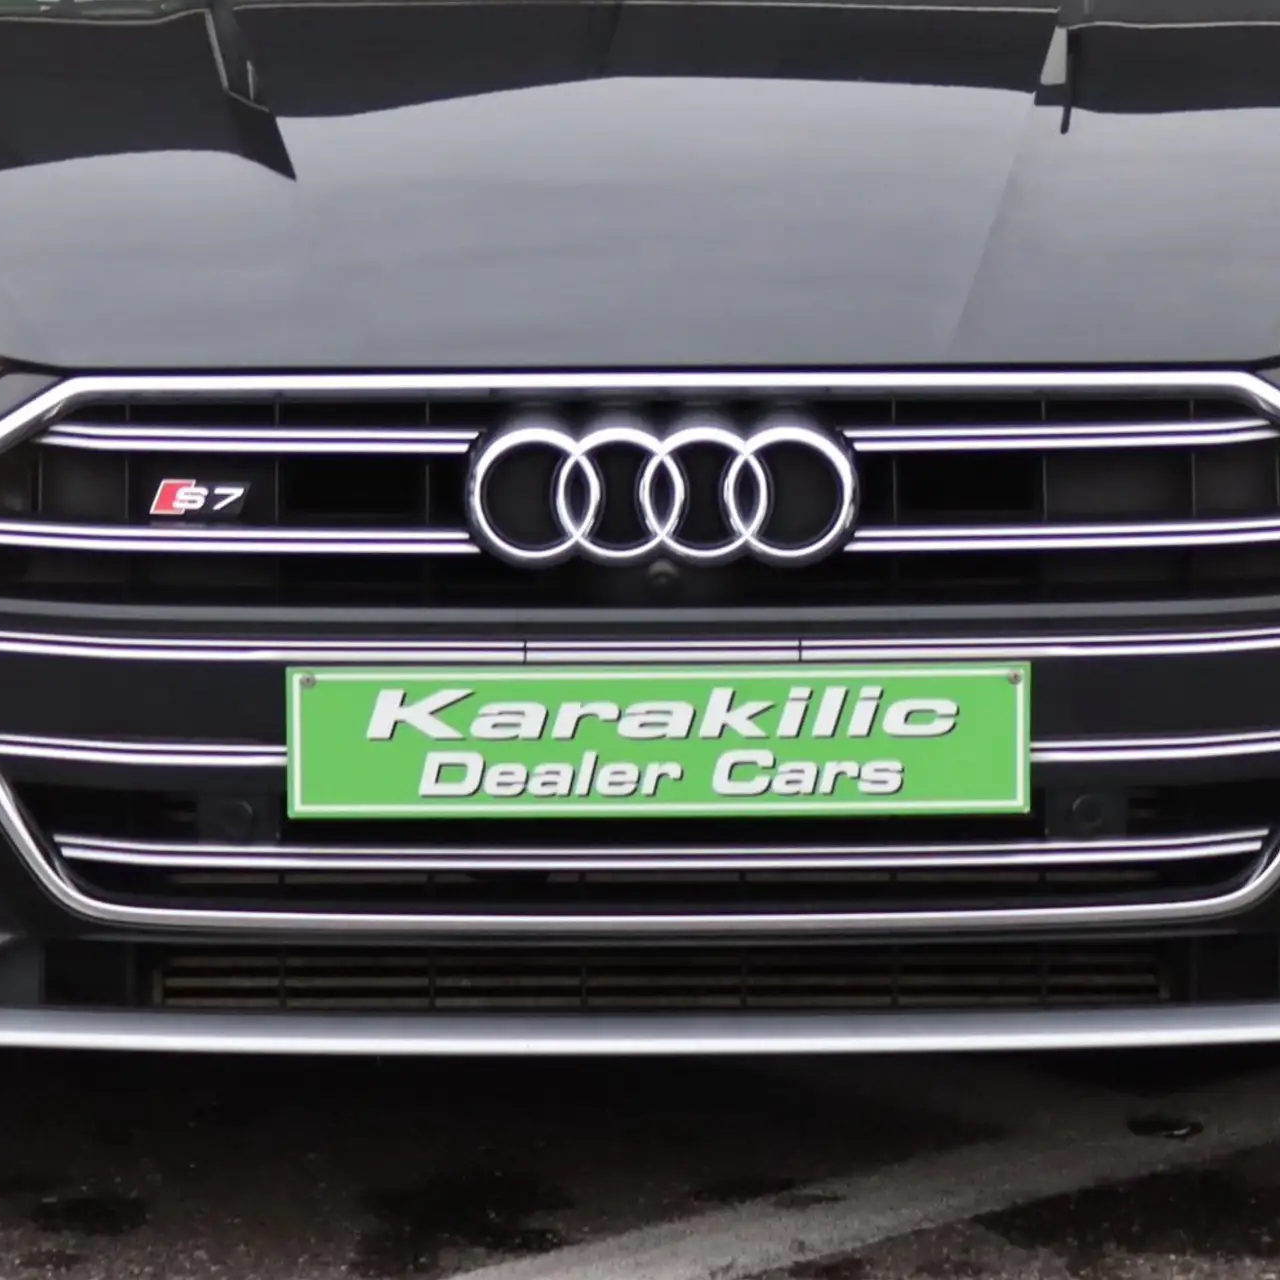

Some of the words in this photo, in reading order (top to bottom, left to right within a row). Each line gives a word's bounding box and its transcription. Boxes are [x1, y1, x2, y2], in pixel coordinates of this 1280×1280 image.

[171, 486, 245, 511] S7
[366, 686, 959, 741] Karakilic
[419, 750, 683, 797] Dealer
[712, 748, 905, 796] Cars
